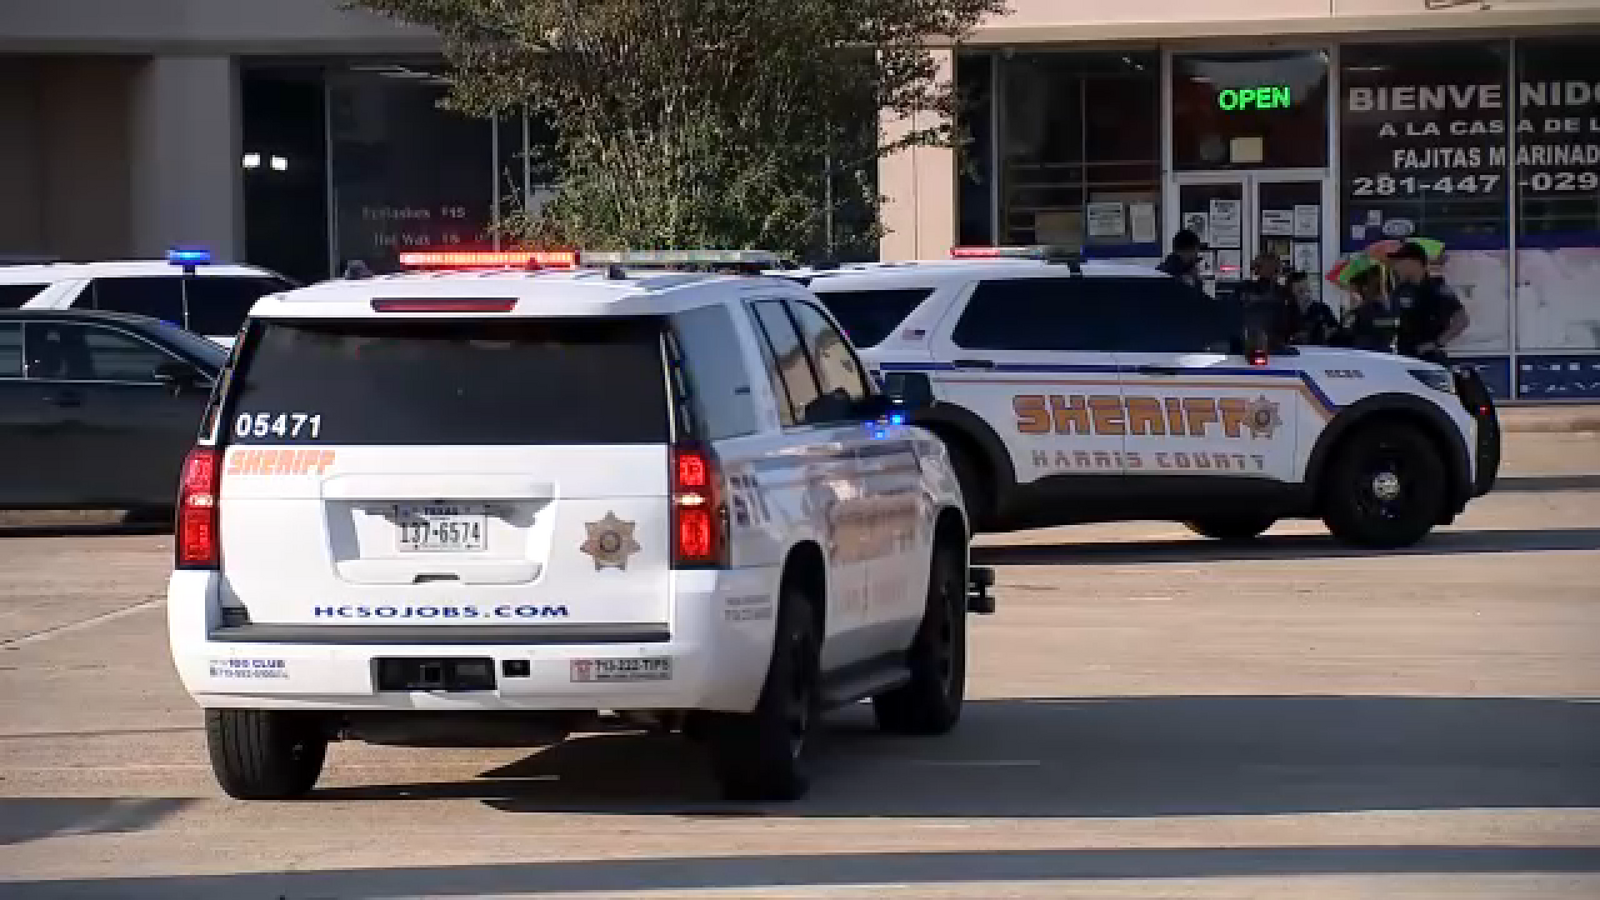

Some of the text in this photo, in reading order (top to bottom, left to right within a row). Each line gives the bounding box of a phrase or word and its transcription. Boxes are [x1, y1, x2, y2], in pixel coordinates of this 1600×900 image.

[1218, 86, 1291, 111] OPEN
[1378, 122, 1398, 137] A
[1406, 122, 1441, 136] LA
[1544, 117, 1580, 132] DE
[1393, 148, 1482, 168] FAJITAS
[236, 412, 322, 438] 05471
[1012, 394, 1248, 438] SHERIFF
[228, 449, 336, 476] SHERIFF
[1031, 449, 1265, 471] HARRIS COUNTY
[313, 606, 569, 619] HCSOJOBS.COM
[252, 659, 286, 668] CLUB
